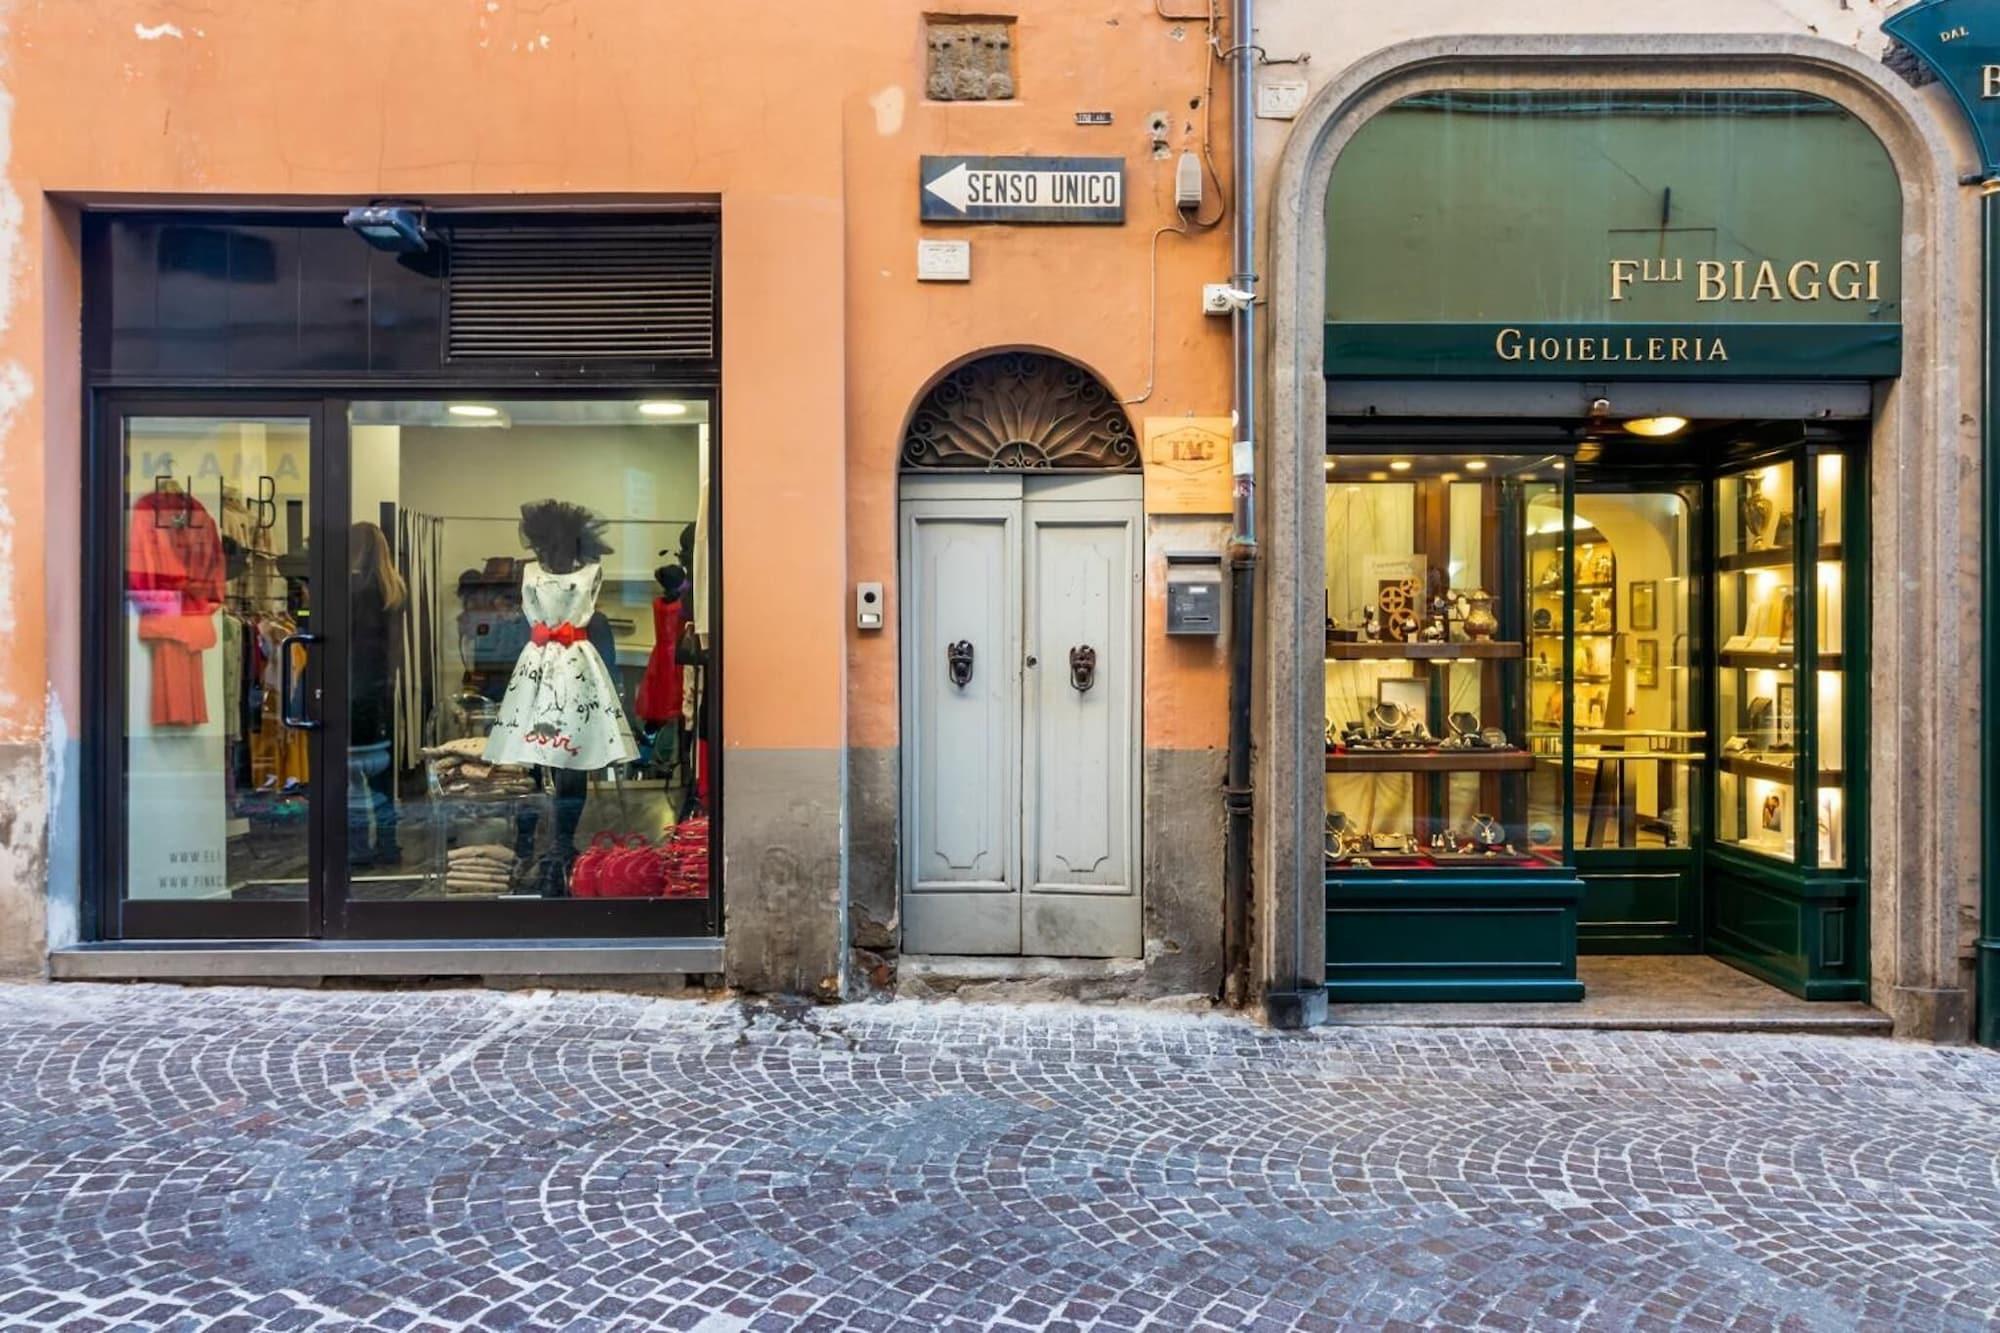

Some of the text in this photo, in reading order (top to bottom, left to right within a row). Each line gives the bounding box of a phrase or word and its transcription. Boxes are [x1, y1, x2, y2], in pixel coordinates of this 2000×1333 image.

[1940, 26, 1969, 43] DAL
[967, 173, 1116, 205] SENSO UNICO
[1695, 259, 1882, 302] BIAGGI
[1495, 328, 1729, 361] GIOIELLERIA
